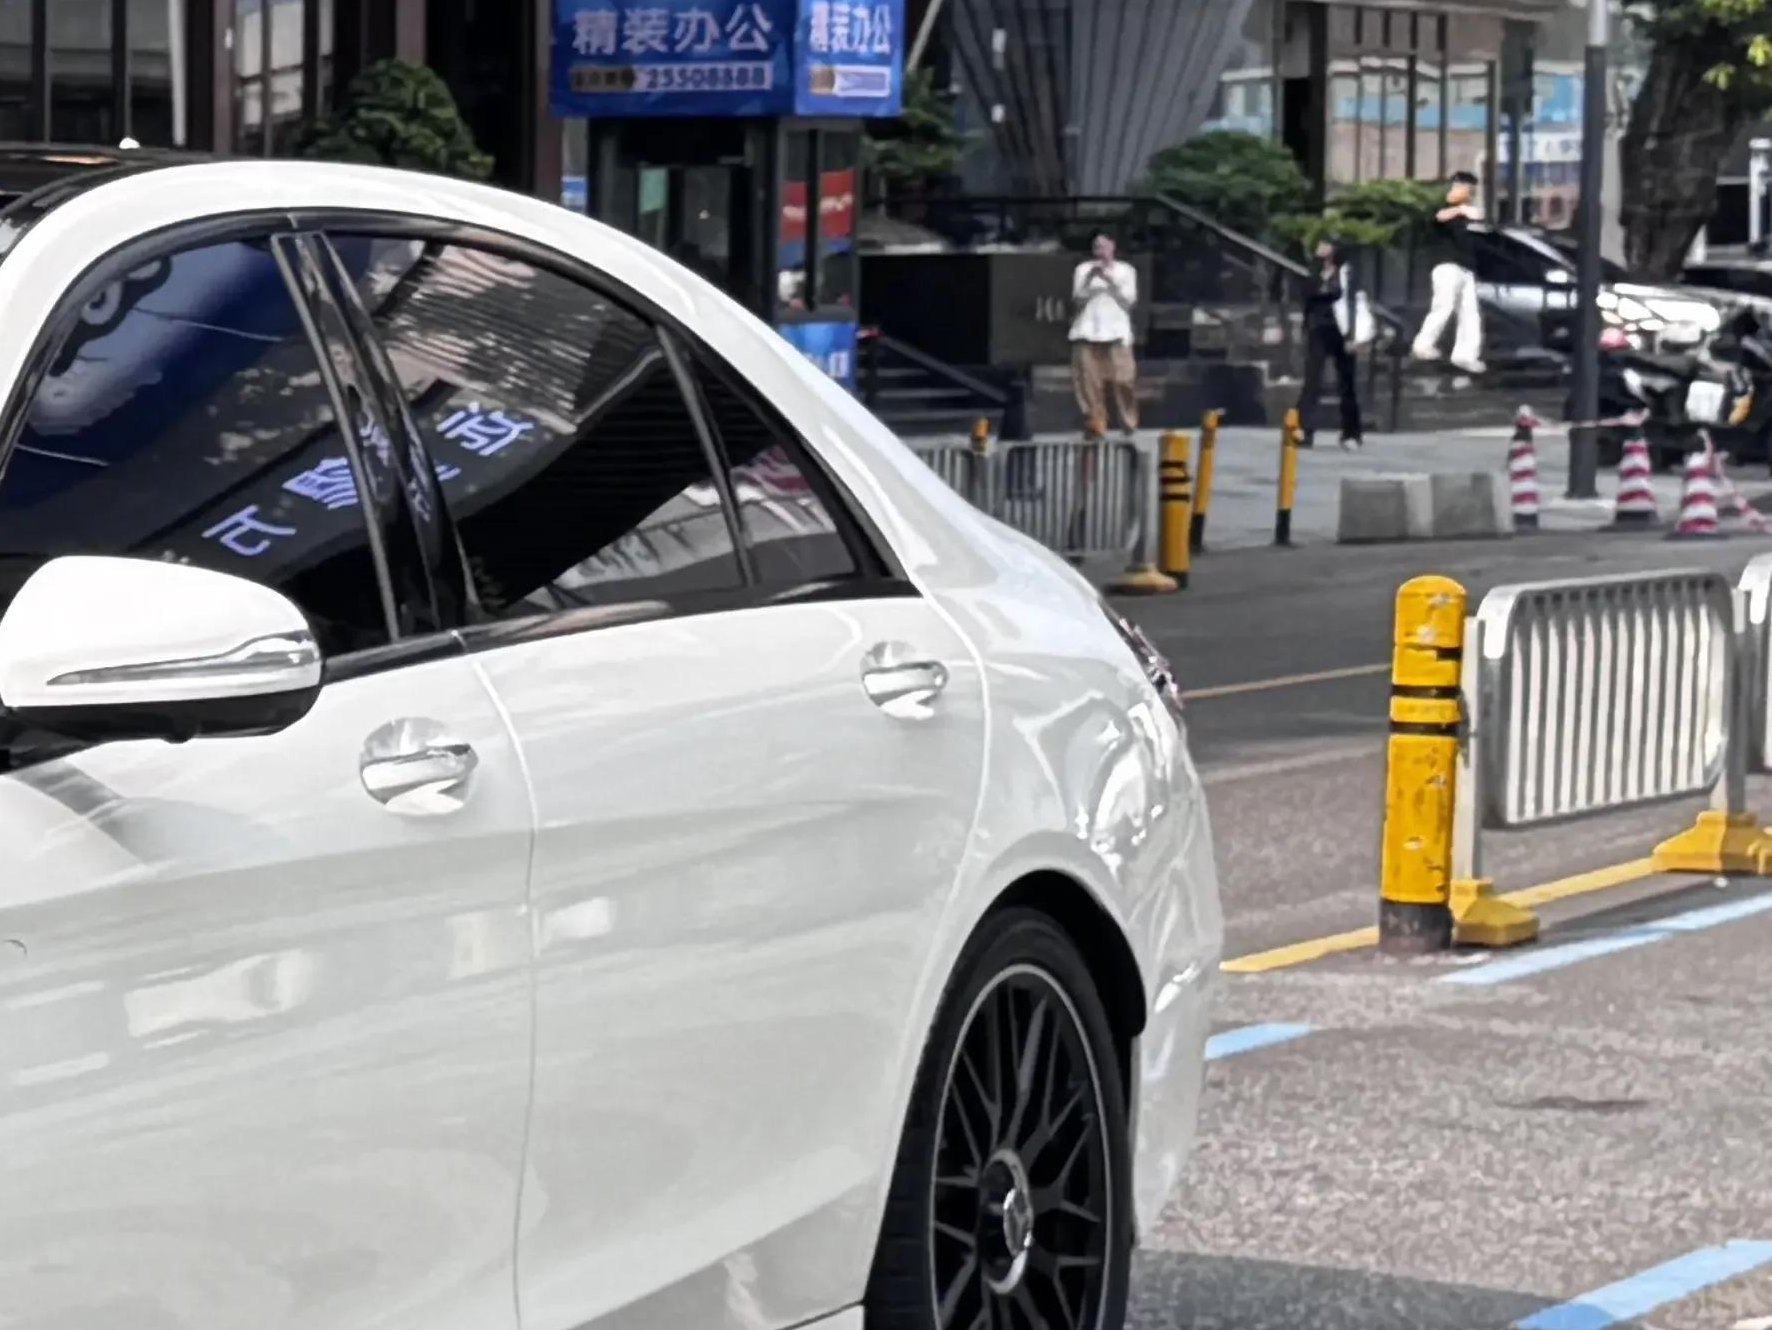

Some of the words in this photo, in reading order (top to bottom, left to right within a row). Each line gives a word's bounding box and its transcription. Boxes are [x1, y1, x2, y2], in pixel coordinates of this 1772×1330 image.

[571, 2, 774, 55] 精装办公
[809, 0, 891, 55] 精装办公
